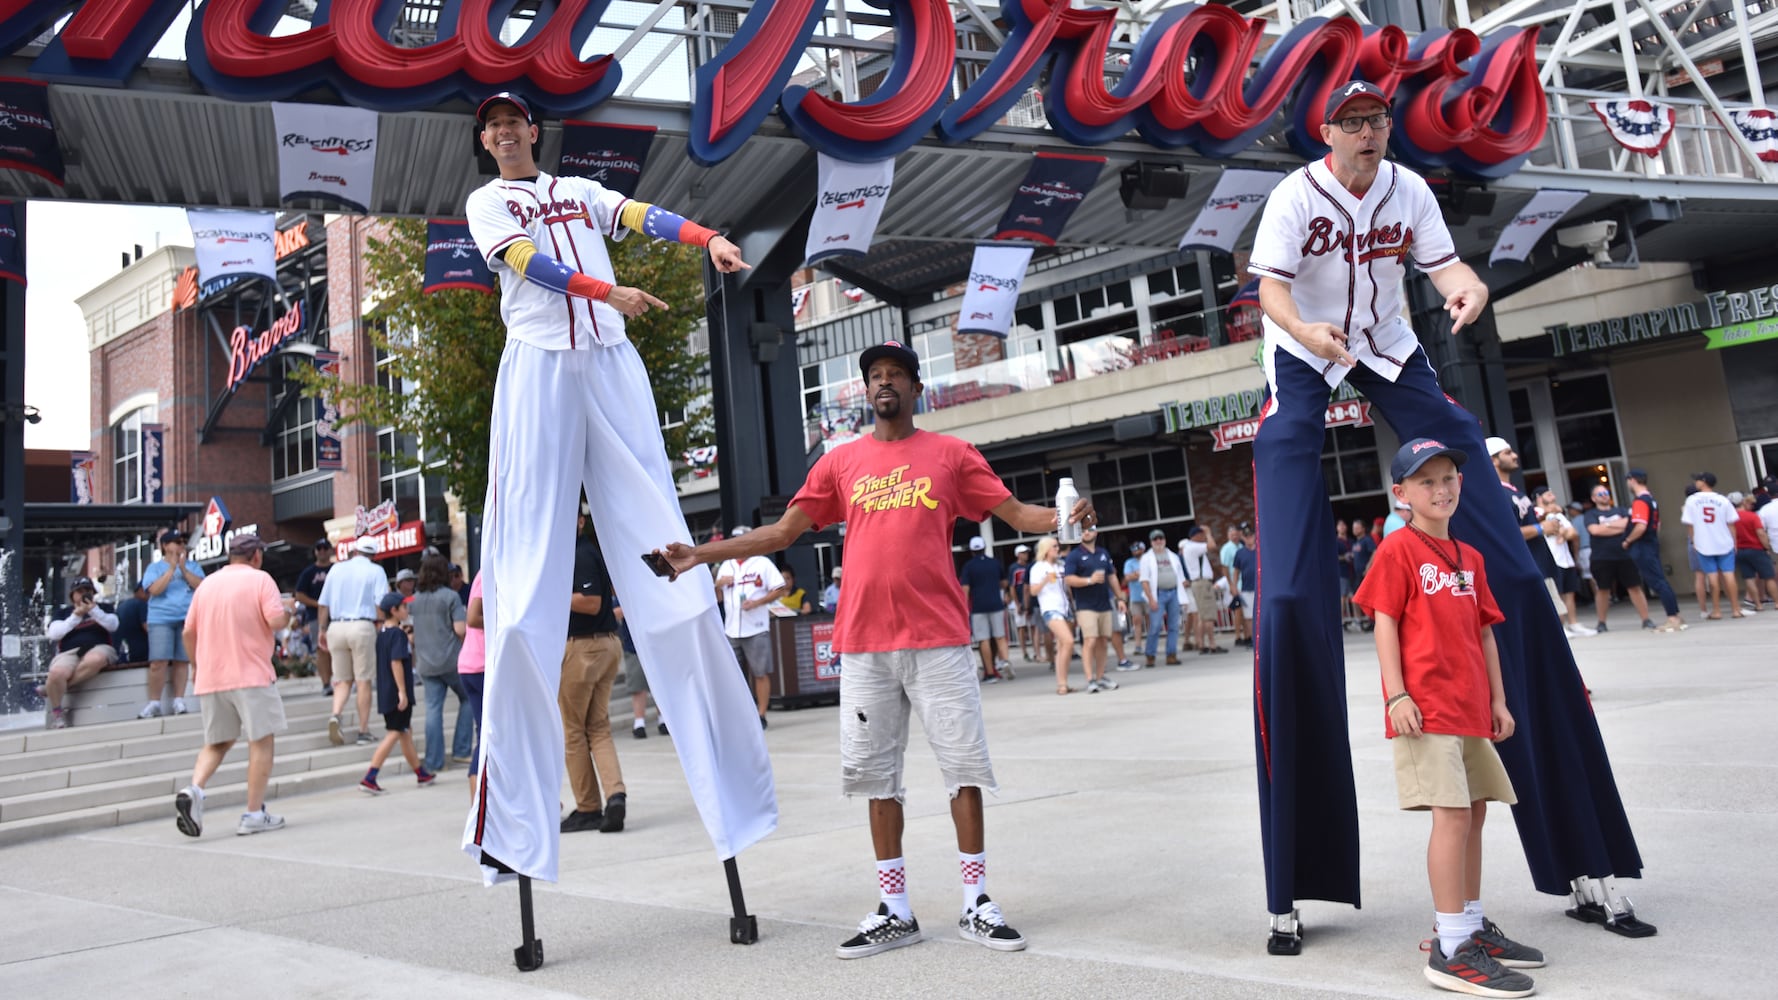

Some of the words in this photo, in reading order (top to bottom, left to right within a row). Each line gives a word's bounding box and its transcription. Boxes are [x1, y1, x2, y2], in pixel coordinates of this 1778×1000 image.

[561, 155, 641, 173] CHAMPIONS
[1302, 216, 1402, 257] Braves
[226, 299, 303, 391] Braves
[1542, 302, 1702, 357] TERRAPIN
[850, 464, 911, 506] STREET
[856, 476, 940, 515] FIGHTER
[1703, 507, 1716, 524] 5
[387, 528, 418, 551] STORE
